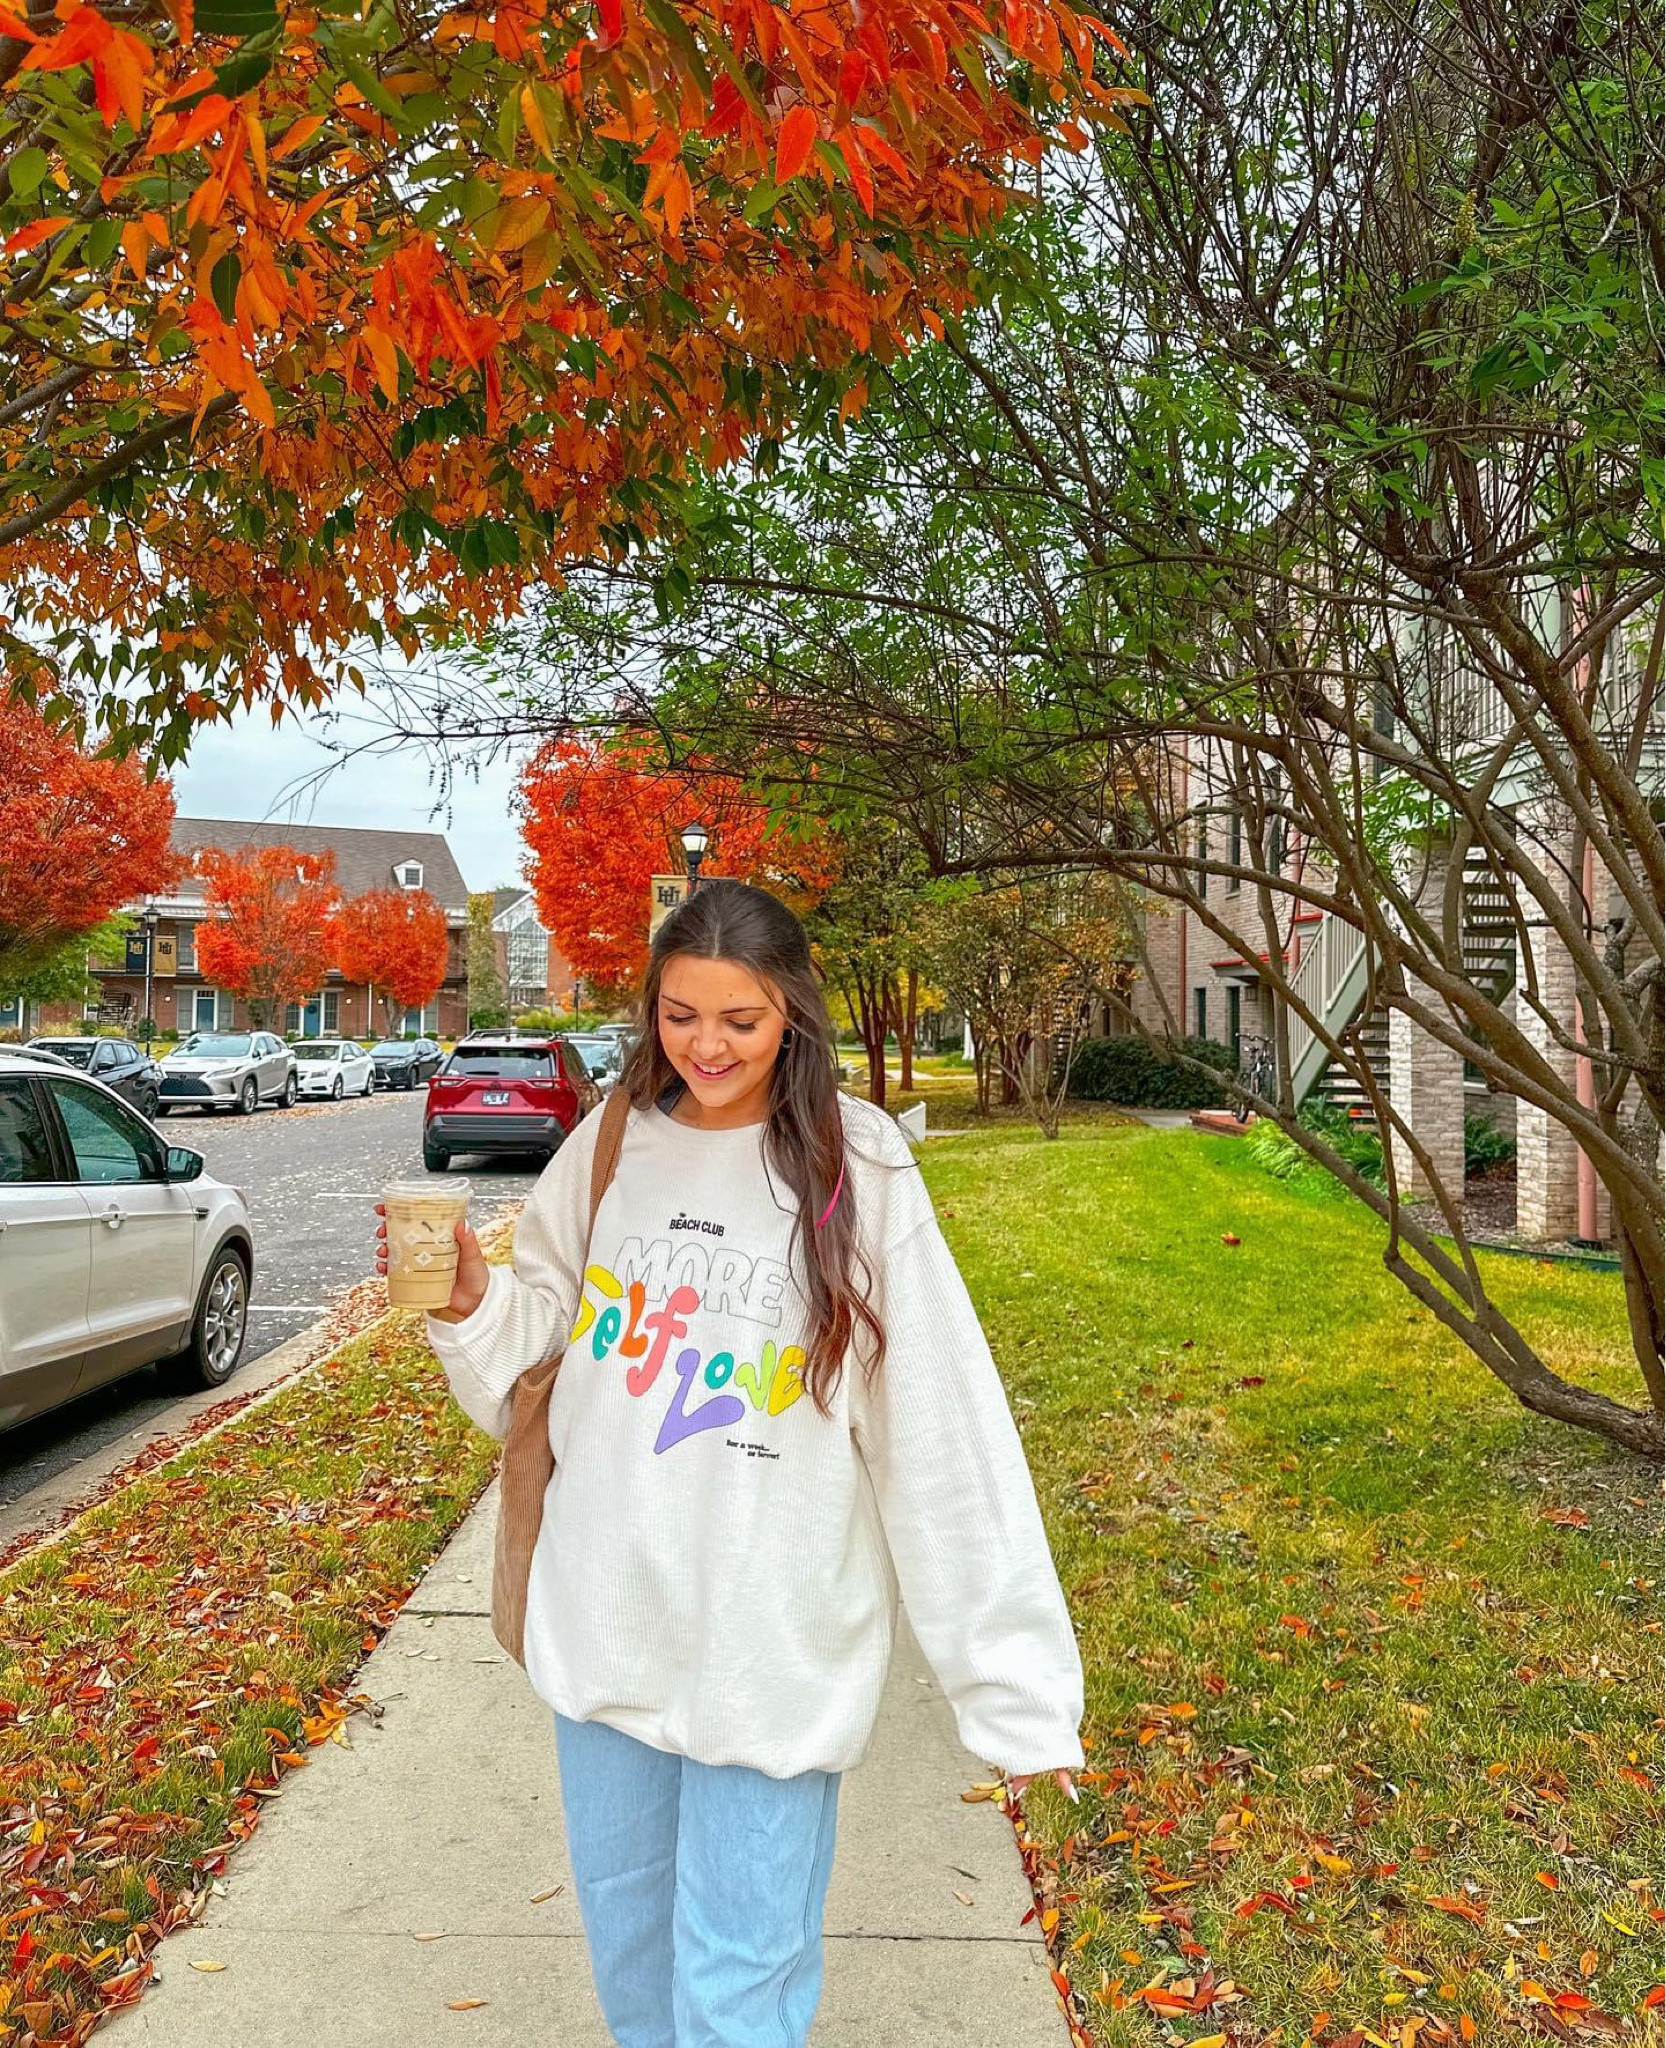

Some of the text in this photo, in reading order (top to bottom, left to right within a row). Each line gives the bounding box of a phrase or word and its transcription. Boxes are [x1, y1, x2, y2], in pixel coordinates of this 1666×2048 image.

[669, 1218, 725, 1237] BEACH CLUB
[612, 1236, 791, 1328] MORE
